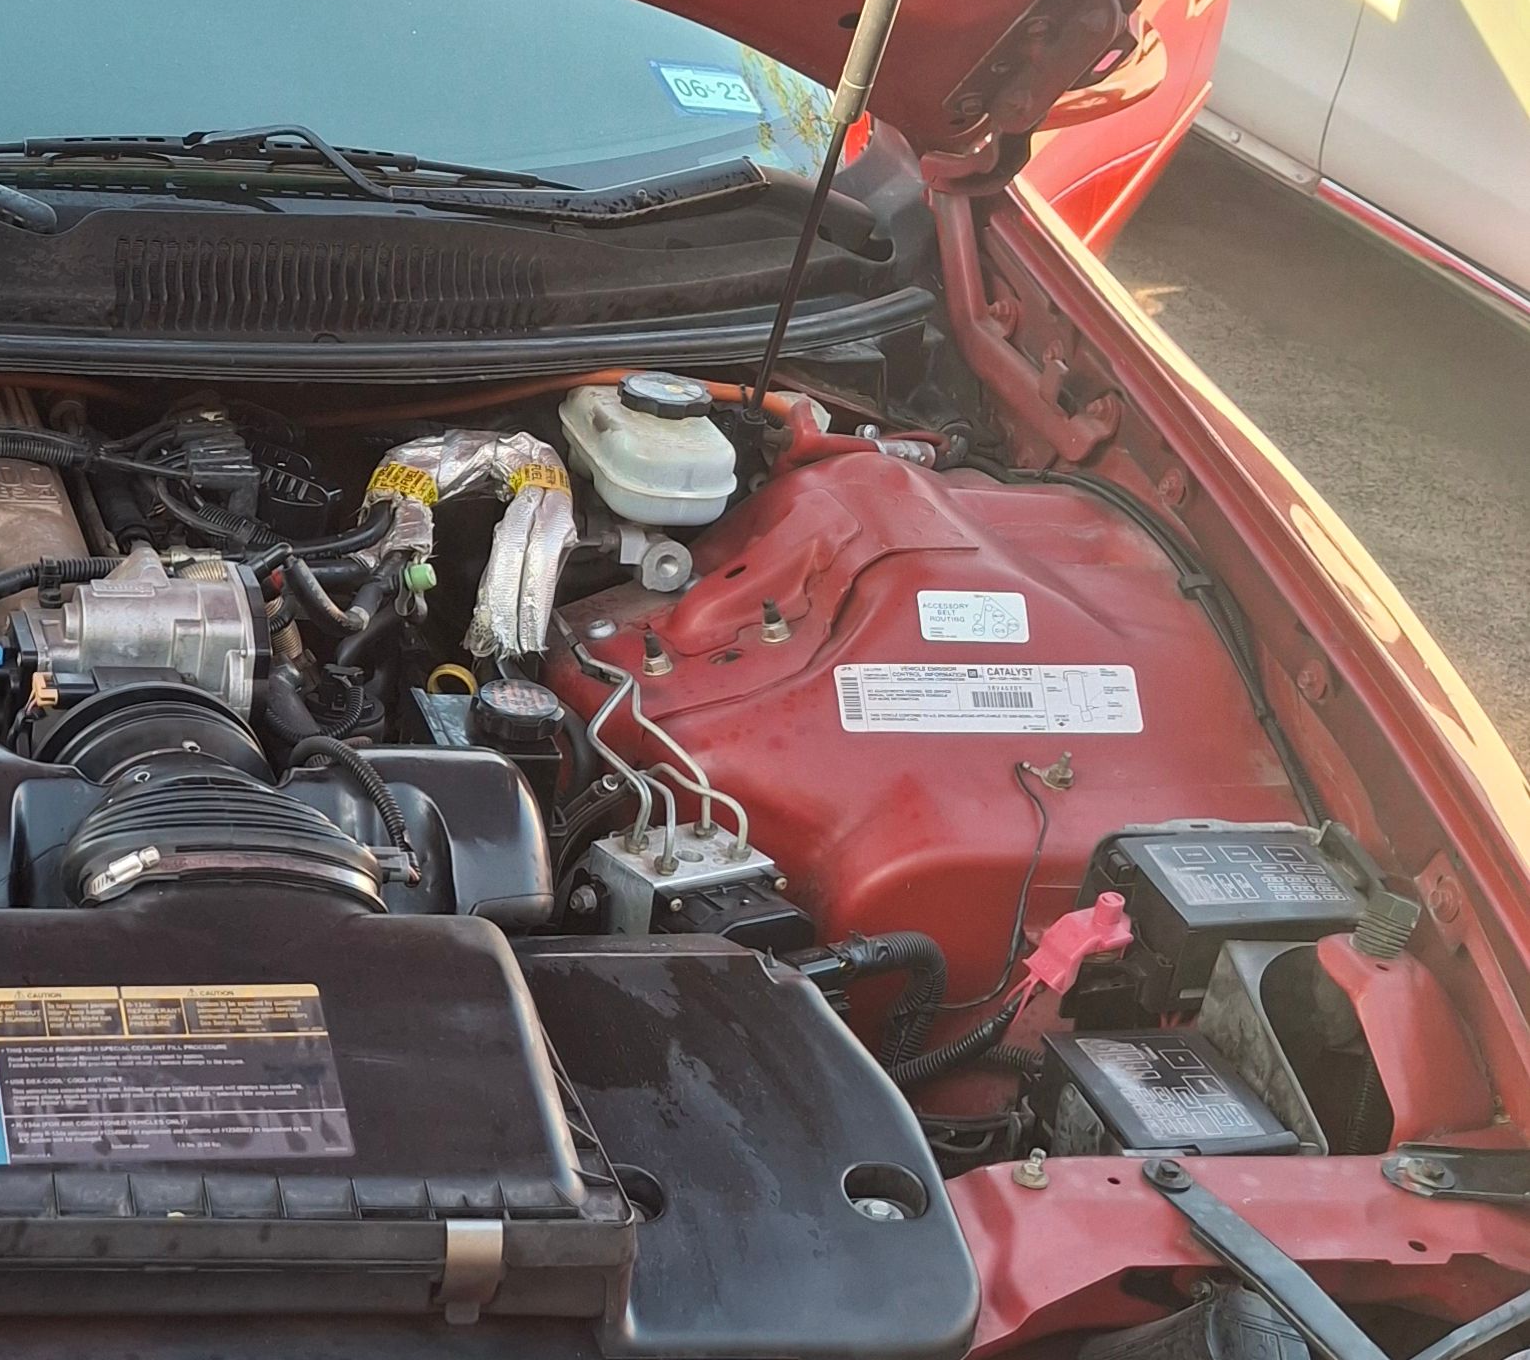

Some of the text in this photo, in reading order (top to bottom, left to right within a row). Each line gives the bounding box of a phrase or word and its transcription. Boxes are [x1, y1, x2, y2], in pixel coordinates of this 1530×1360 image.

[674, 78, 751, 102] 06 23
[922, 602, 969, 610] ACCESSORY
[987, 666, 1033, 676] CATALYST
